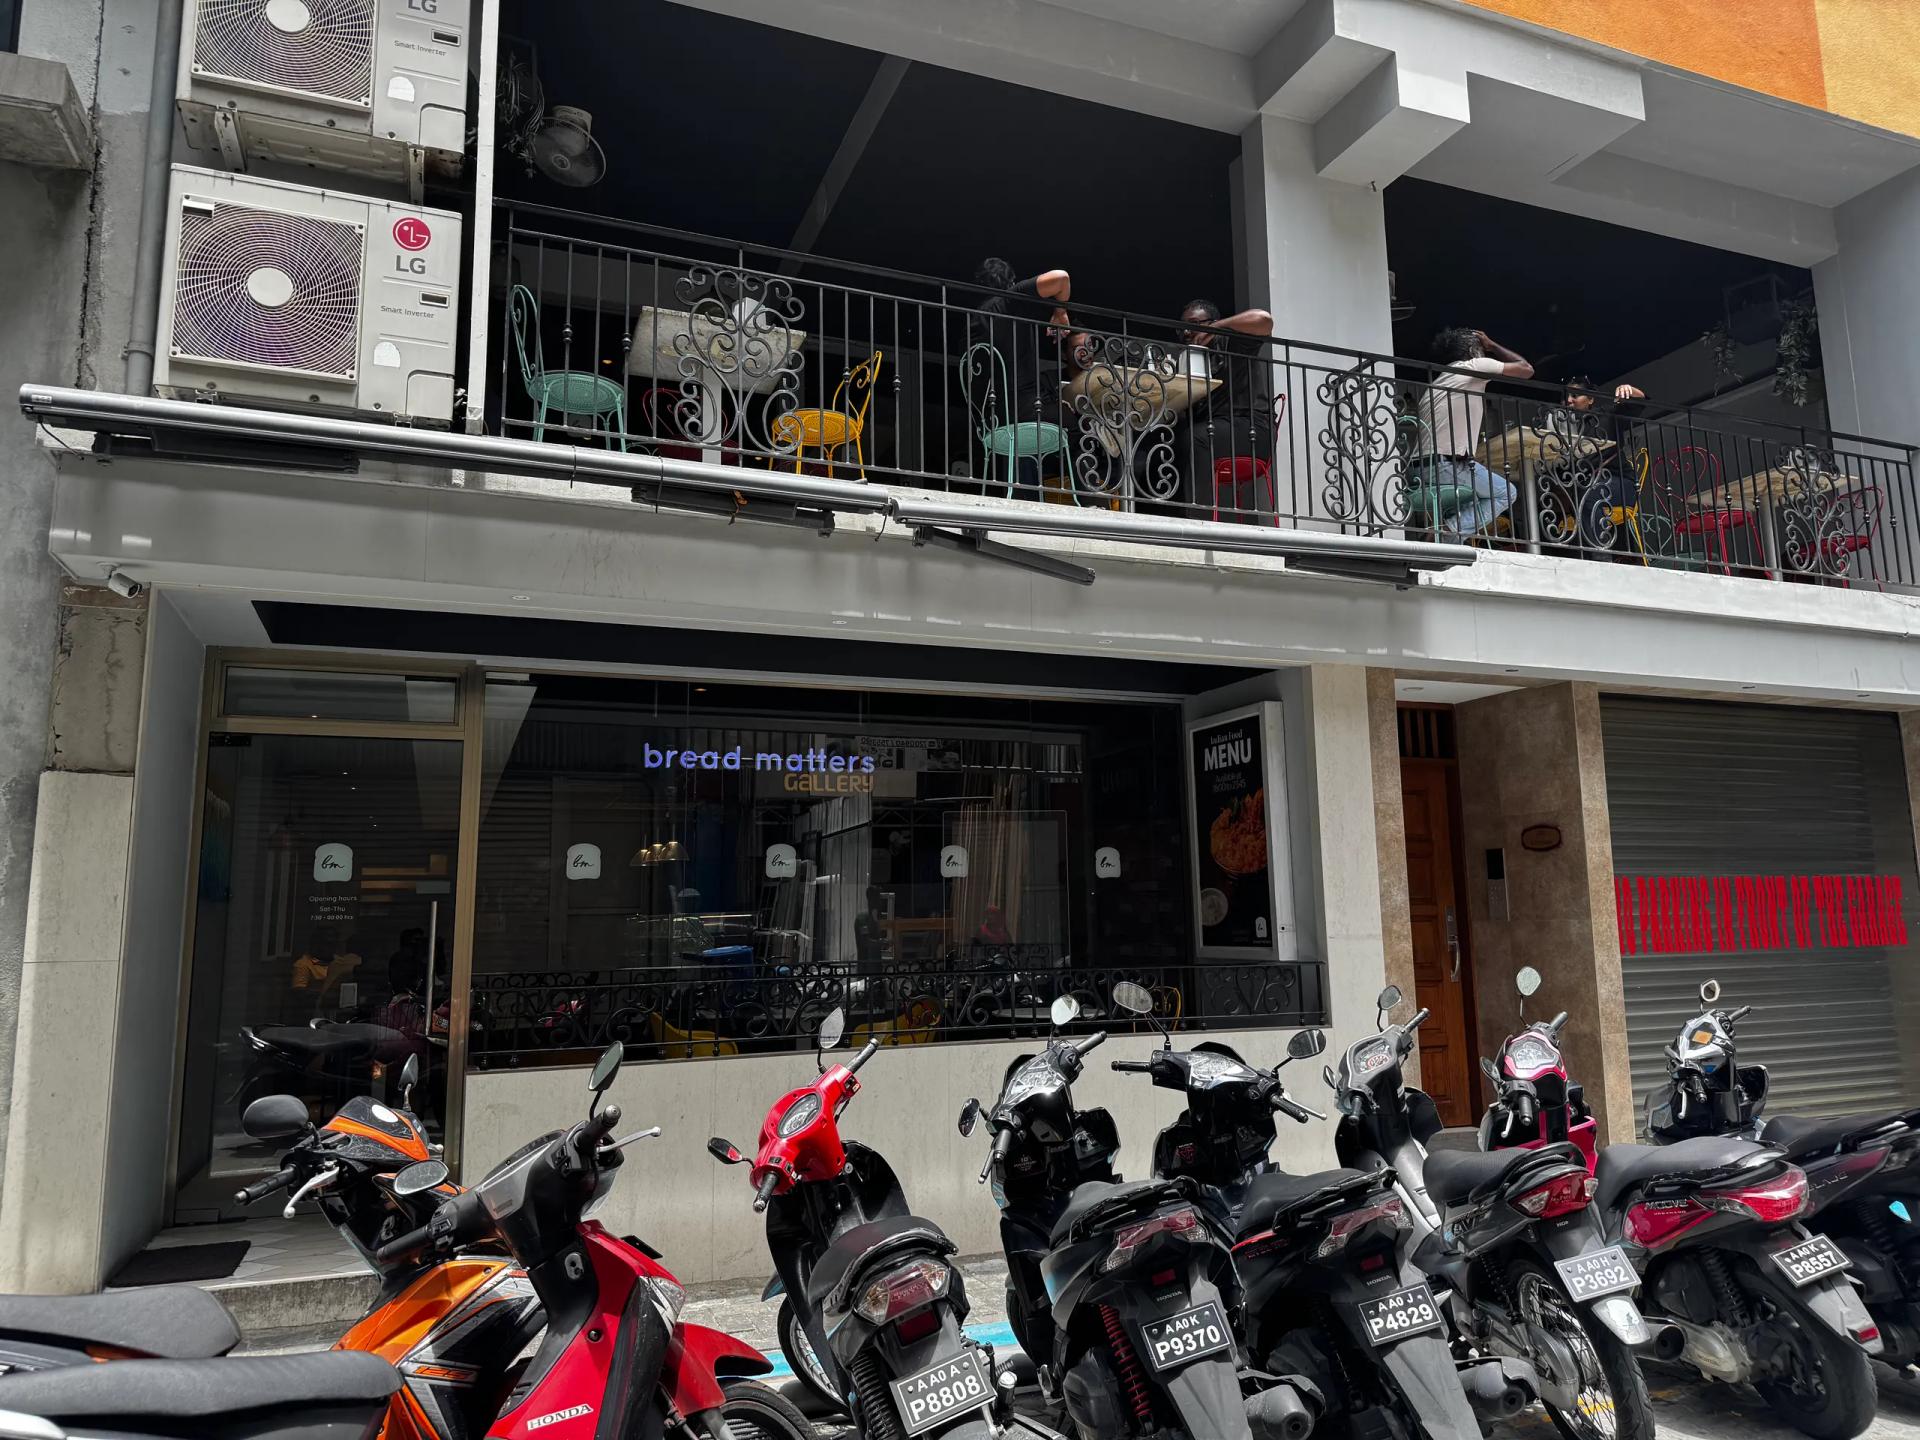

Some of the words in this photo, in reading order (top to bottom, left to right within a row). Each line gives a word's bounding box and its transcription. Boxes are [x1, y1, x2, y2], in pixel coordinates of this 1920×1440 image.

[408, 0, 437, 14] LG
[394, 40, 416, 50] Smart
[417, 45, 447, 56] Inverter
[396, 255, 426, 275] LG
[380, 305, 402, 315] Smart
[404, 308, 434, 319] Inverter
[1228, 728, 1243, 740] Food
[644, 742, 741, 769] bread
[755, 747, 875, 774] matters
[1204, 737, 1252, 772] MENU
[308, 895, 336, 903] Opening
[1635, 874, 1714, 955] PARKING
[1713, 875, 1736, 953] IN
[1735, 874, 1790, 951] FRONT
[1790, 874, 1813, 950] OF
[1811, 873, 1849, 948] THE
[1845, 873, 1908, 948] GARAGE
[1790, 1250, 1838, 1279] P8557
[1366, 1274, 1392, 1287] HONDA
[1572, 1265, 1630, 1294] P3692
[1369, 1303, 1433, 1336] P4829
[1155, 1325, 1221, 1361] P9370
[909, 1375, 981, 1422] P8808
[529, 1404, 592, 1429] HONDA
